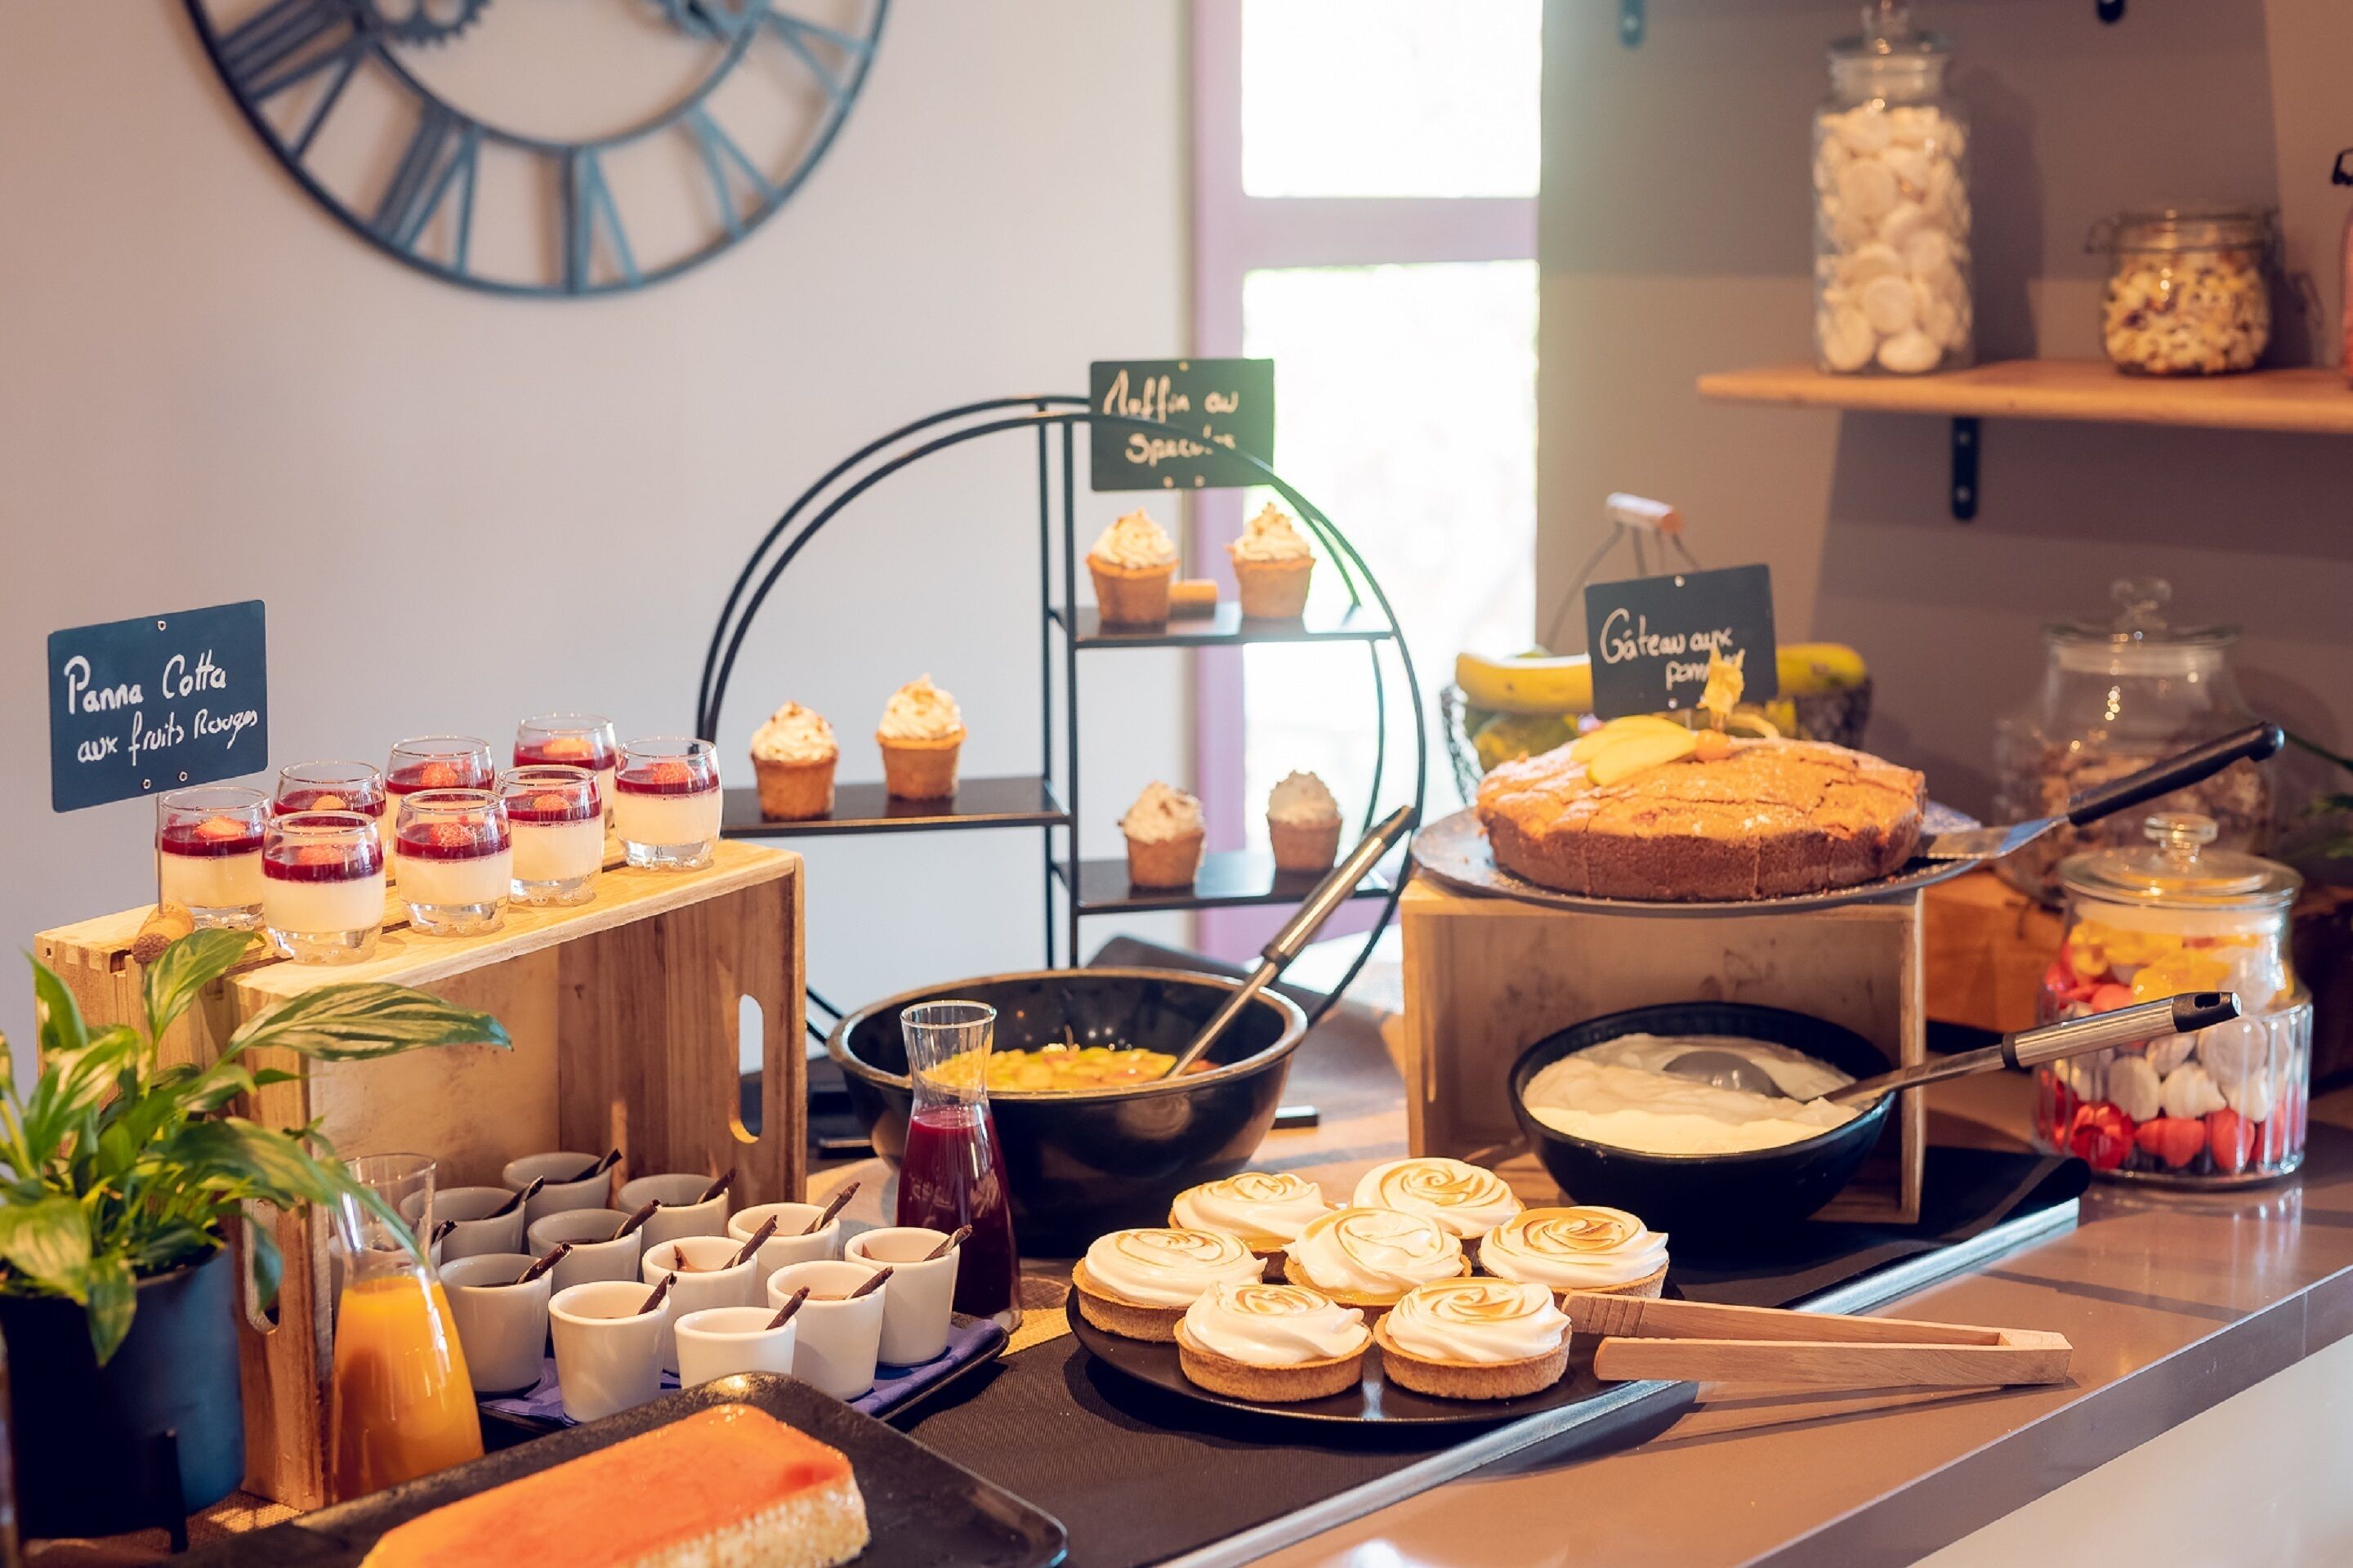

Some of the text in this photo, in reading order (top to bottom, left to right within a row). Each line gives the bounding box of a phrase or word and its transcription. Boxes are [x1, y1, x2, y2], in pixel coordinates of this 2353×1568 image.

[1690, 627, 1733, 652] aux
[64, 649, 226, 715] Panna Cotta
[78, 736, 118, 763] aux
[128, 710, 185, 766] fruits
